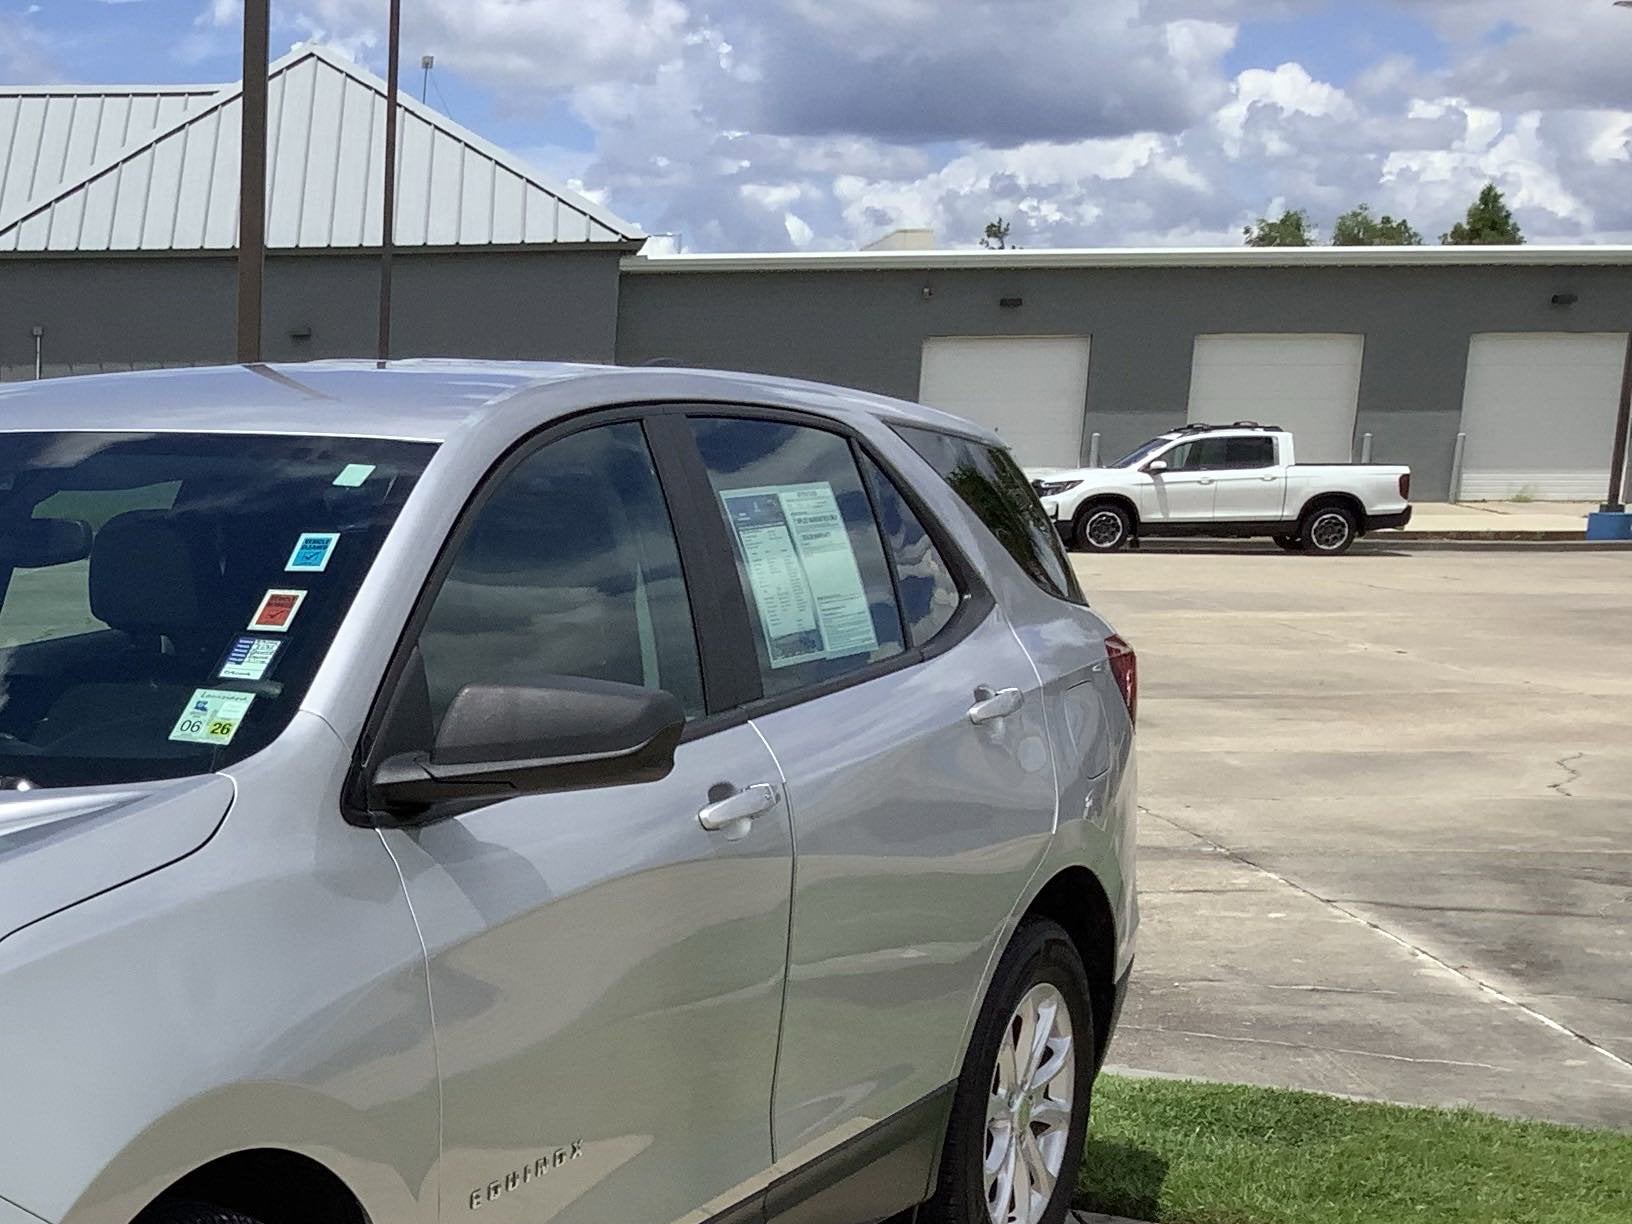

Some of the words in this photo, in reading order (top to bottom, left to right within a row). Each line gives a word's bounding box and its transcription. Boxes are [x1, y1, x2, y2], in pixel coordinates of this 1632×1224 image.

[179, 719, 203, 733] 06
[209, 722, 233, 735] 26
[469, 1138, 585, 1210] EQUINOX
